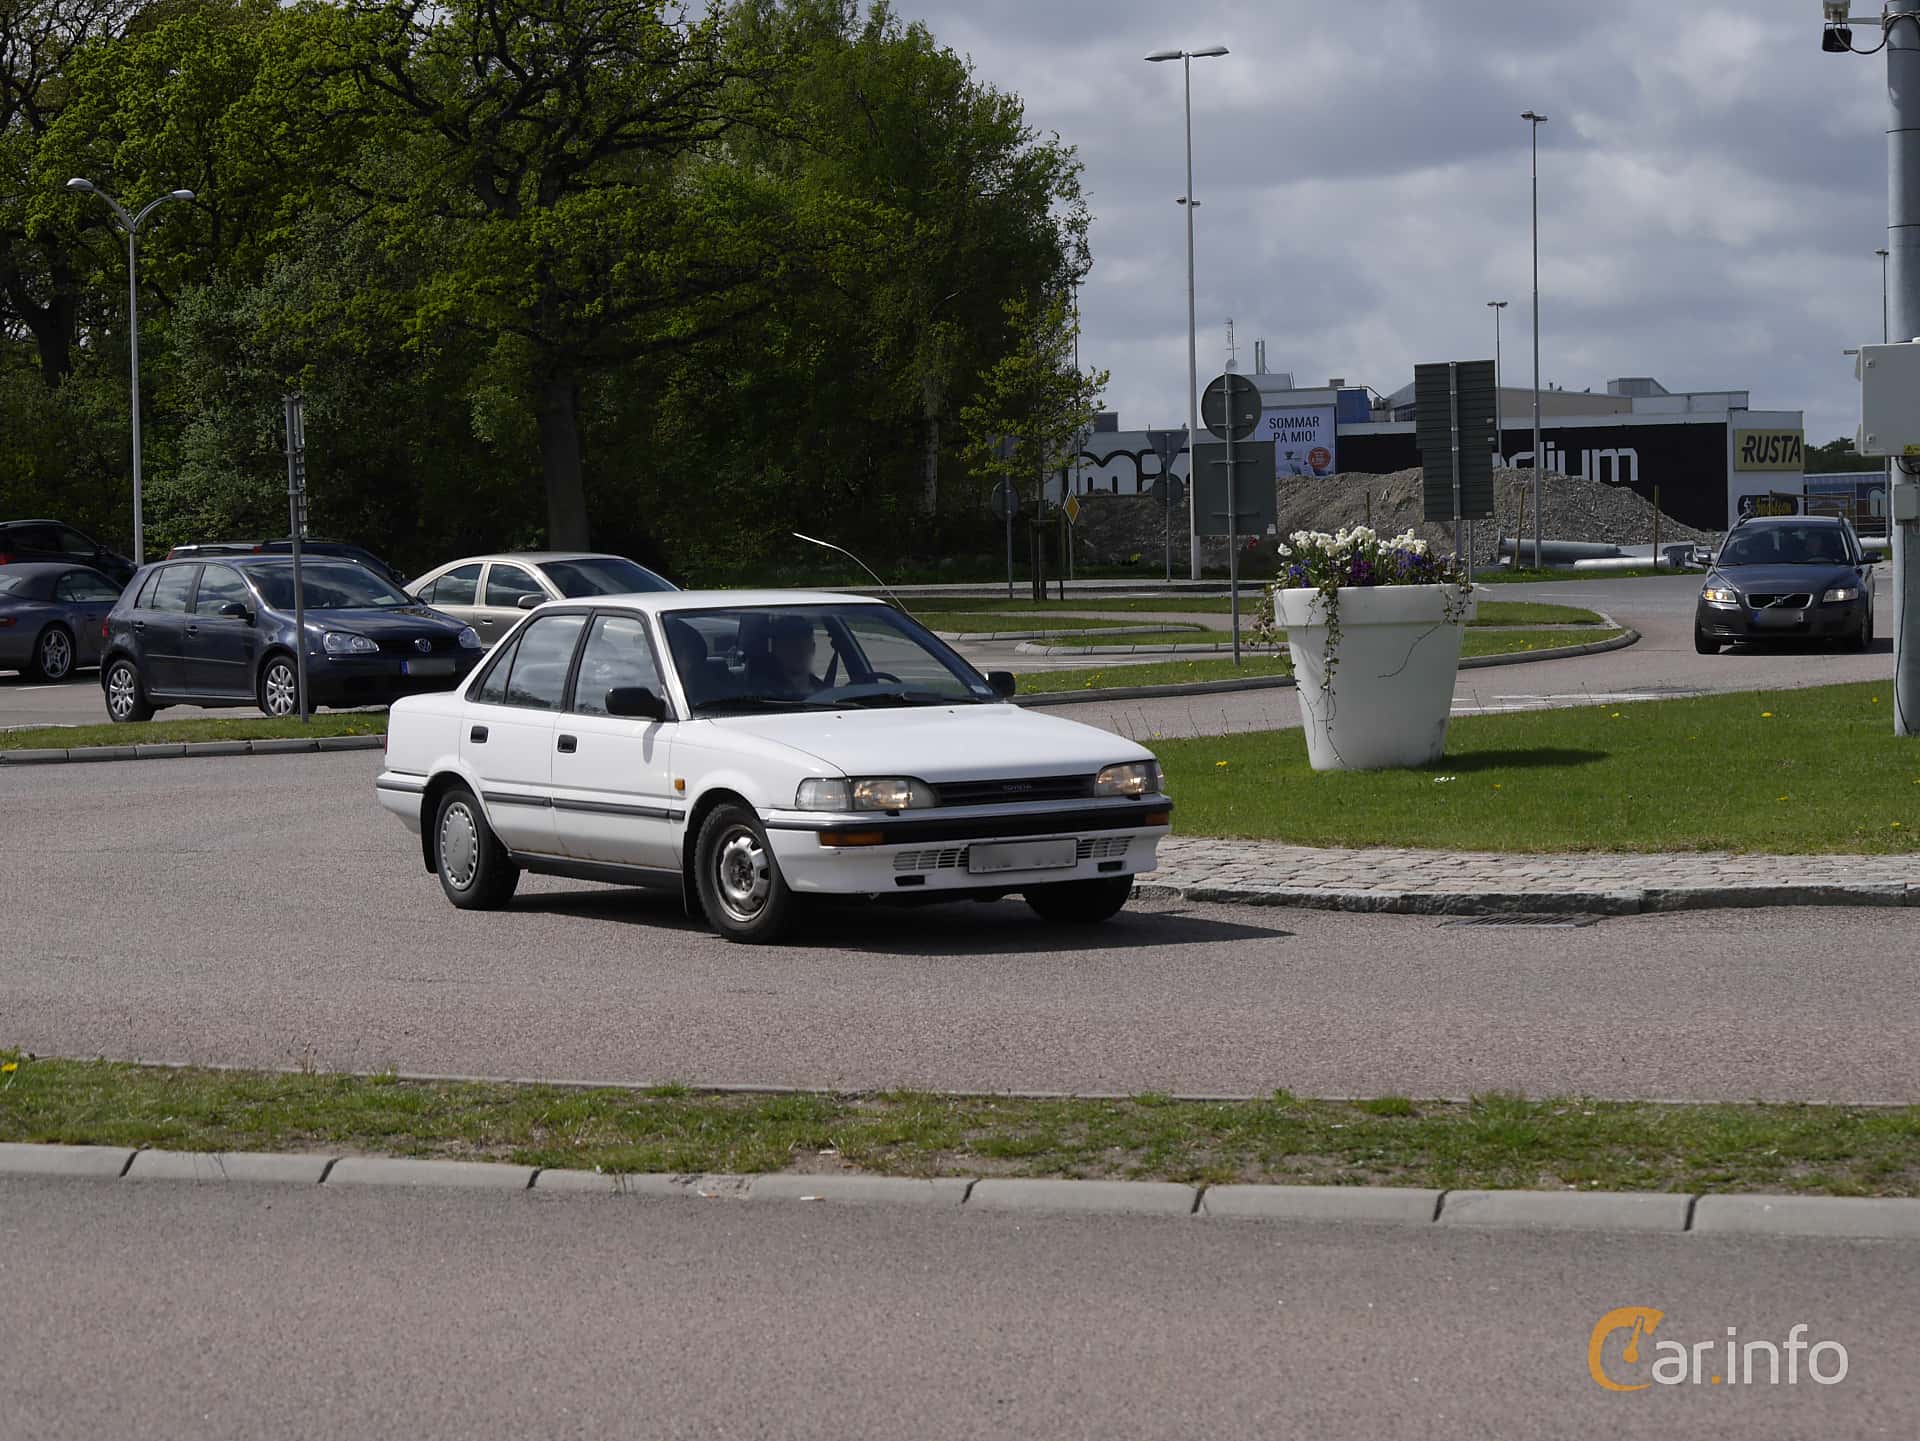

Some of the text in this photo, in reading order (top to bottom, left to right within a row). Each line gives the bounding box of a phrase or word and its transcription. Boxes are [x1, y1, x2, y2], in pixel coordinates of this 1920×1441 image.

[1269, 415, 1320, 429] SOMMAR
[1273, 429, 1316, 443] PÅ MIO!
[1742, 434, 1801, 463] RUSTA
